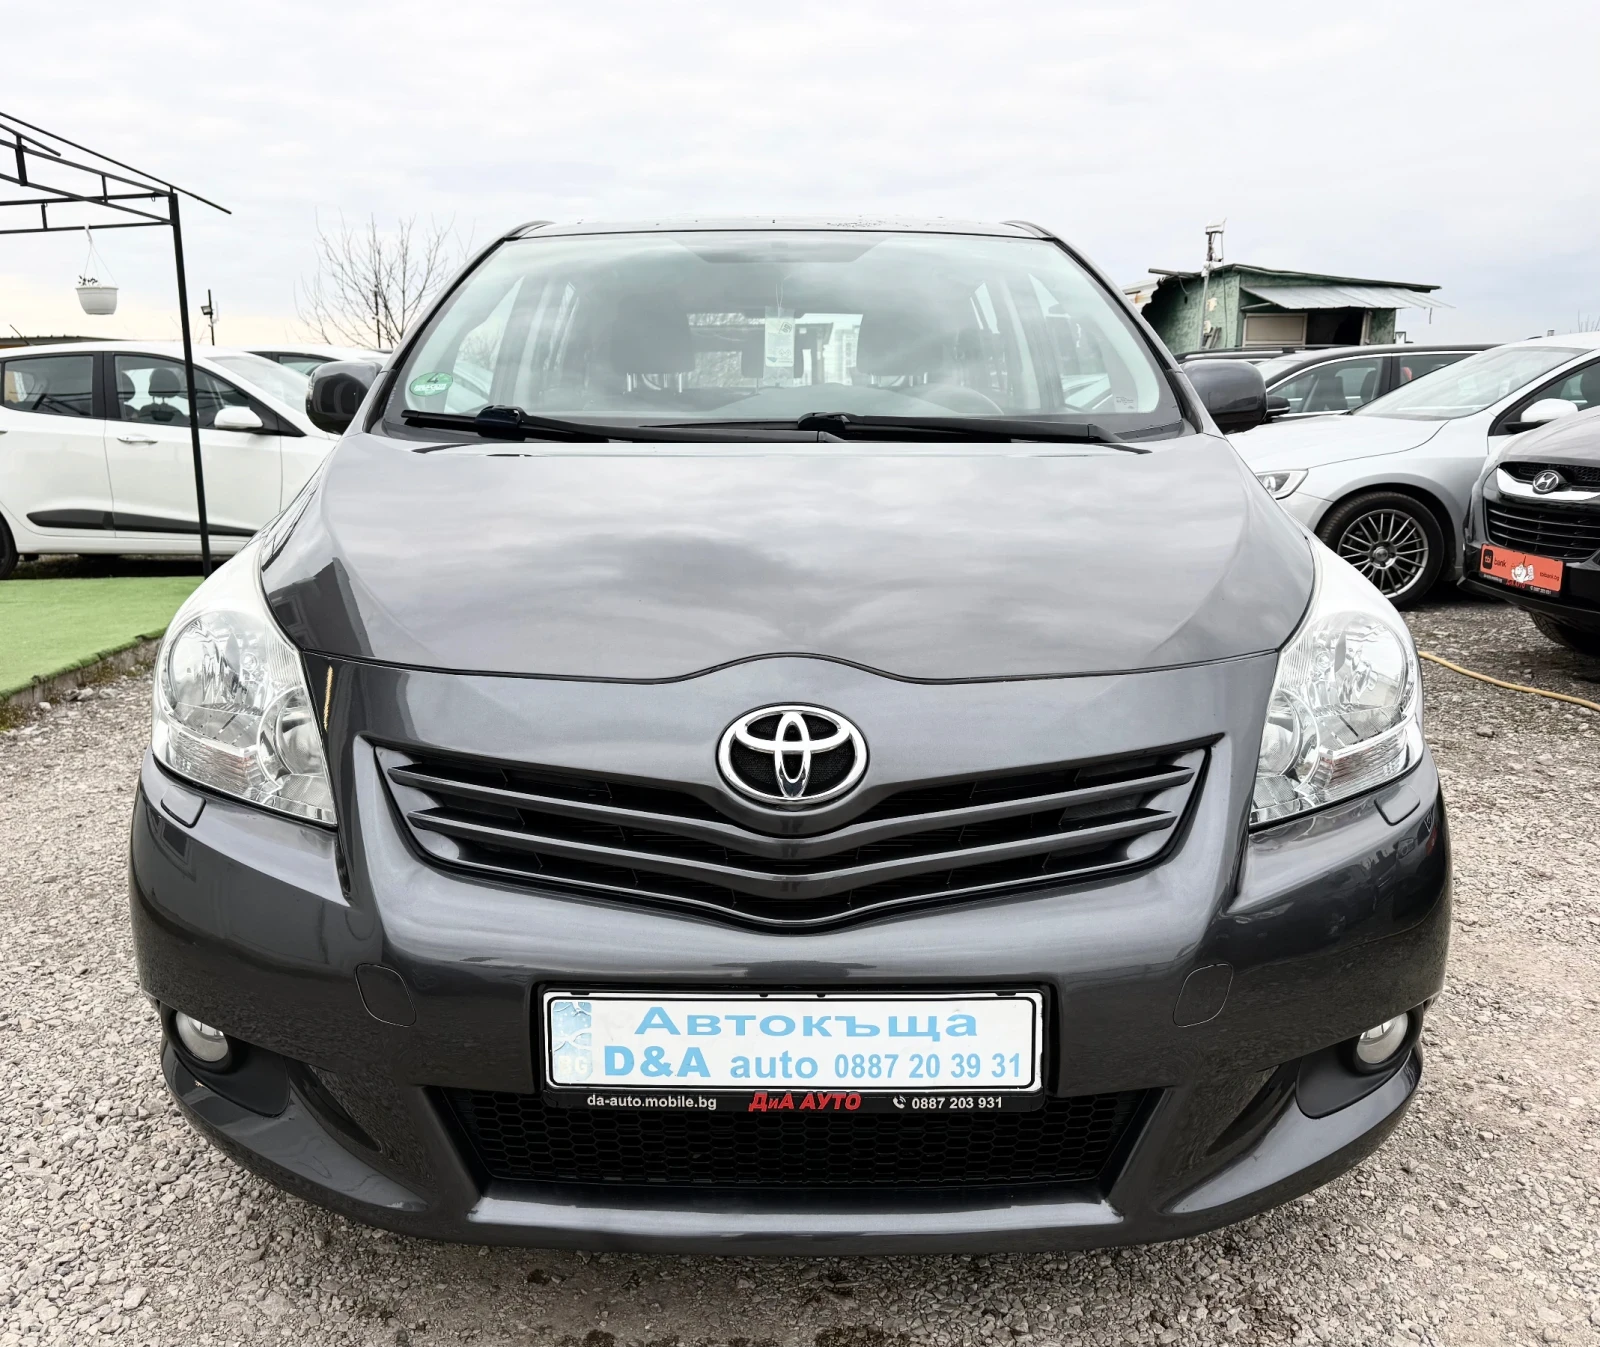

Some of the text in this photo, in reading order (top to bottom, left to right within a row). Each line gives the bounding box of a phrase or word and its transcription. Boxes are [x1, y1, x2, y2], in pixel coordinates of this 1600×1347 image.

[1494, 557, 1506, 567] bank
[635, 1006, 978, 1043] Автокъща
[558, 1055, 589, 1075] BG
[604, 1045, 1020, 1079] D&A auto 0887 20 39 31
[586, 1093, 718, 1111] da-auto.mobile.bg
[799, 1090, 862, 1111] АУТО
[911, 1096, 1002, 1110] 0887 203 931
